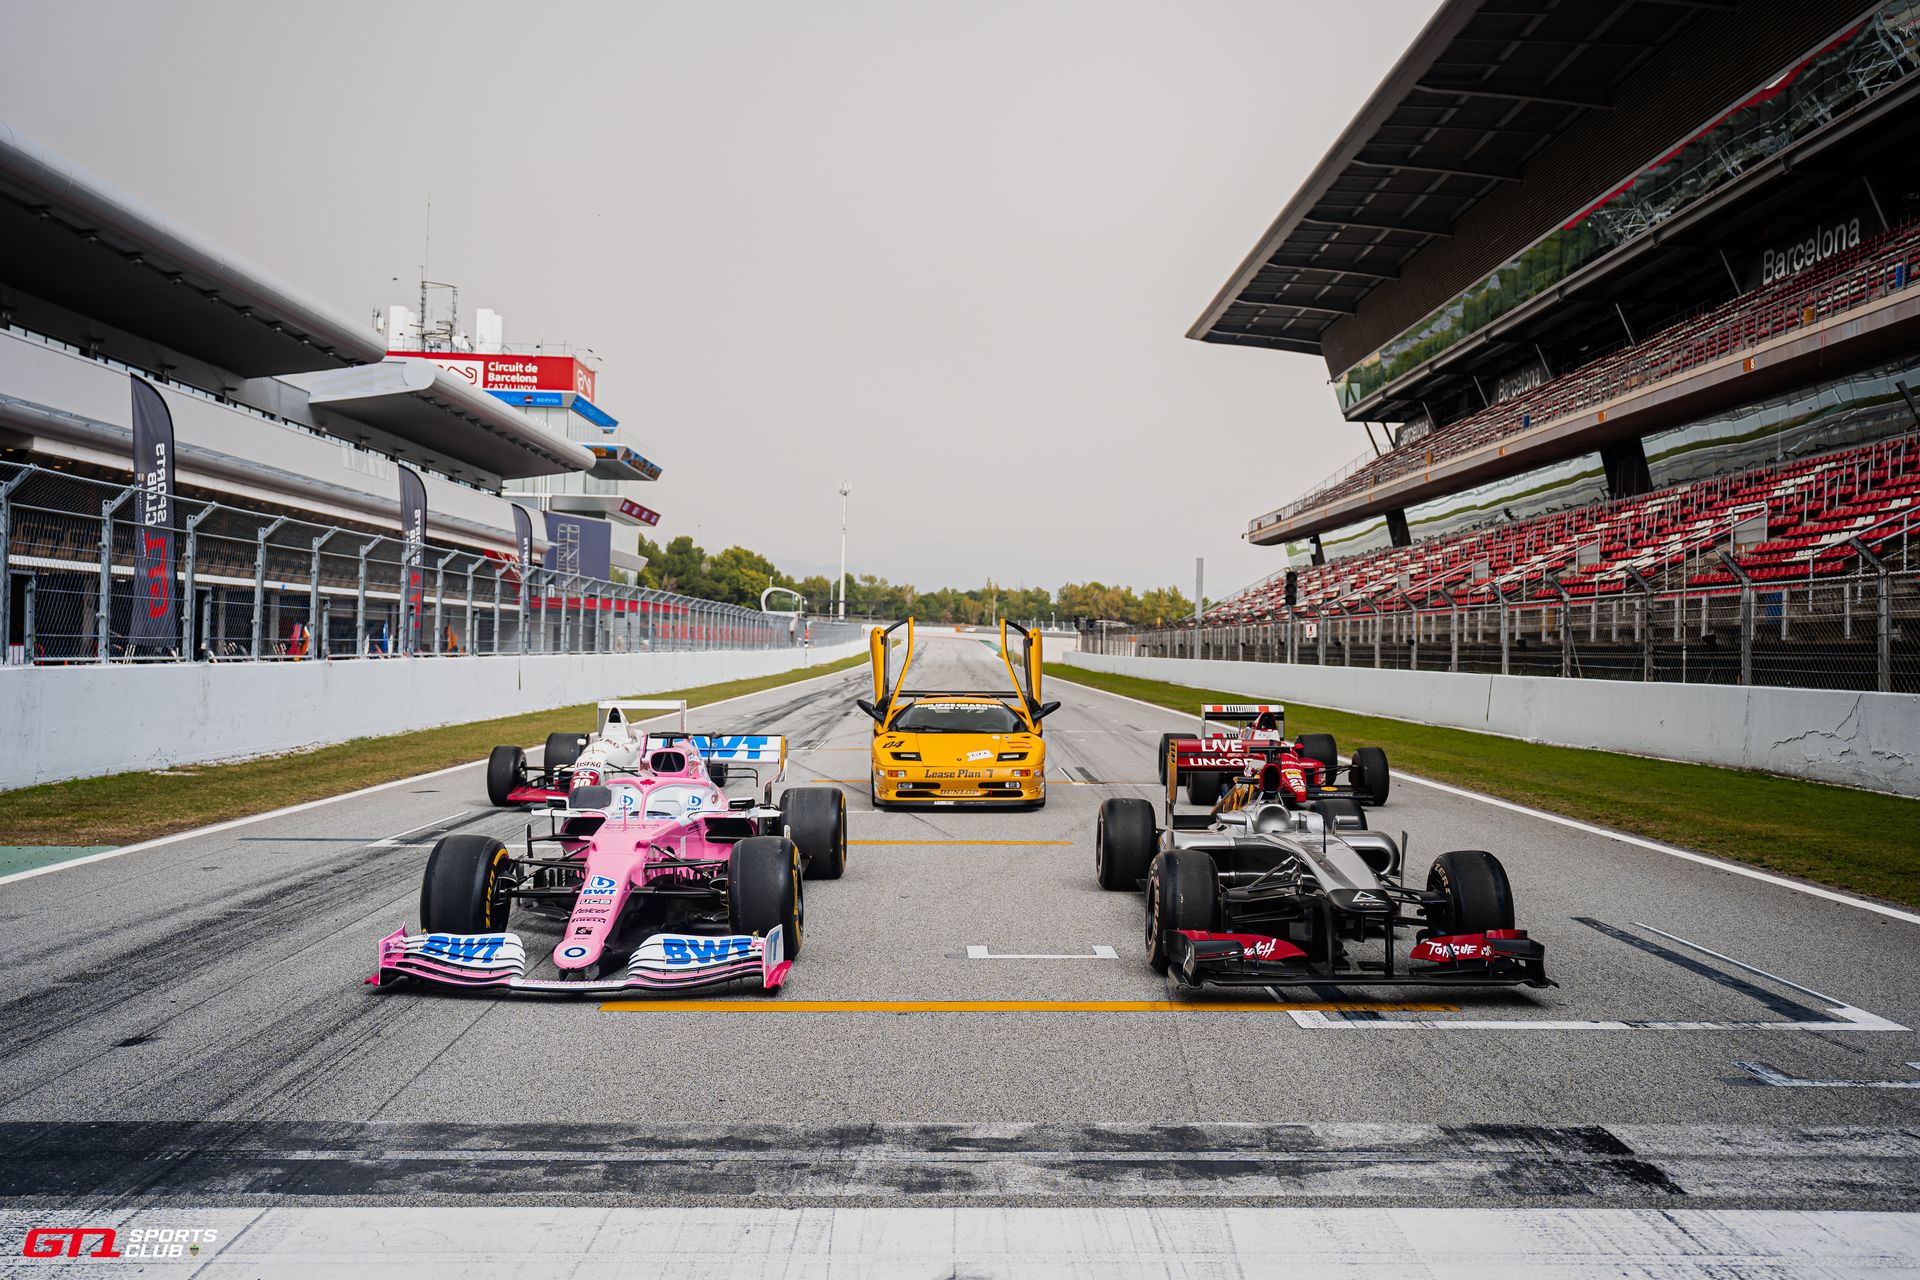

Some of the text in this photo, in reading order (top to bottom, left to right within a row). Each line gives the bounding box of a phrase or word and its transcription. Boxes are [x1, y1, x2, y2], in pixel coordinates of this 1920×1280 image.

[1763, 217, 1860, 285] Barcelona
[488, 361, 539, 373] Circuit de
[487, 372, 538, 383] Barcelona
[1201, 740, 1244, 752] LIVE
[925, 768, 981, 778] Lease Plan
[419, 936, 506, 963] BWT
[662, 938, 752, 965] BWT
